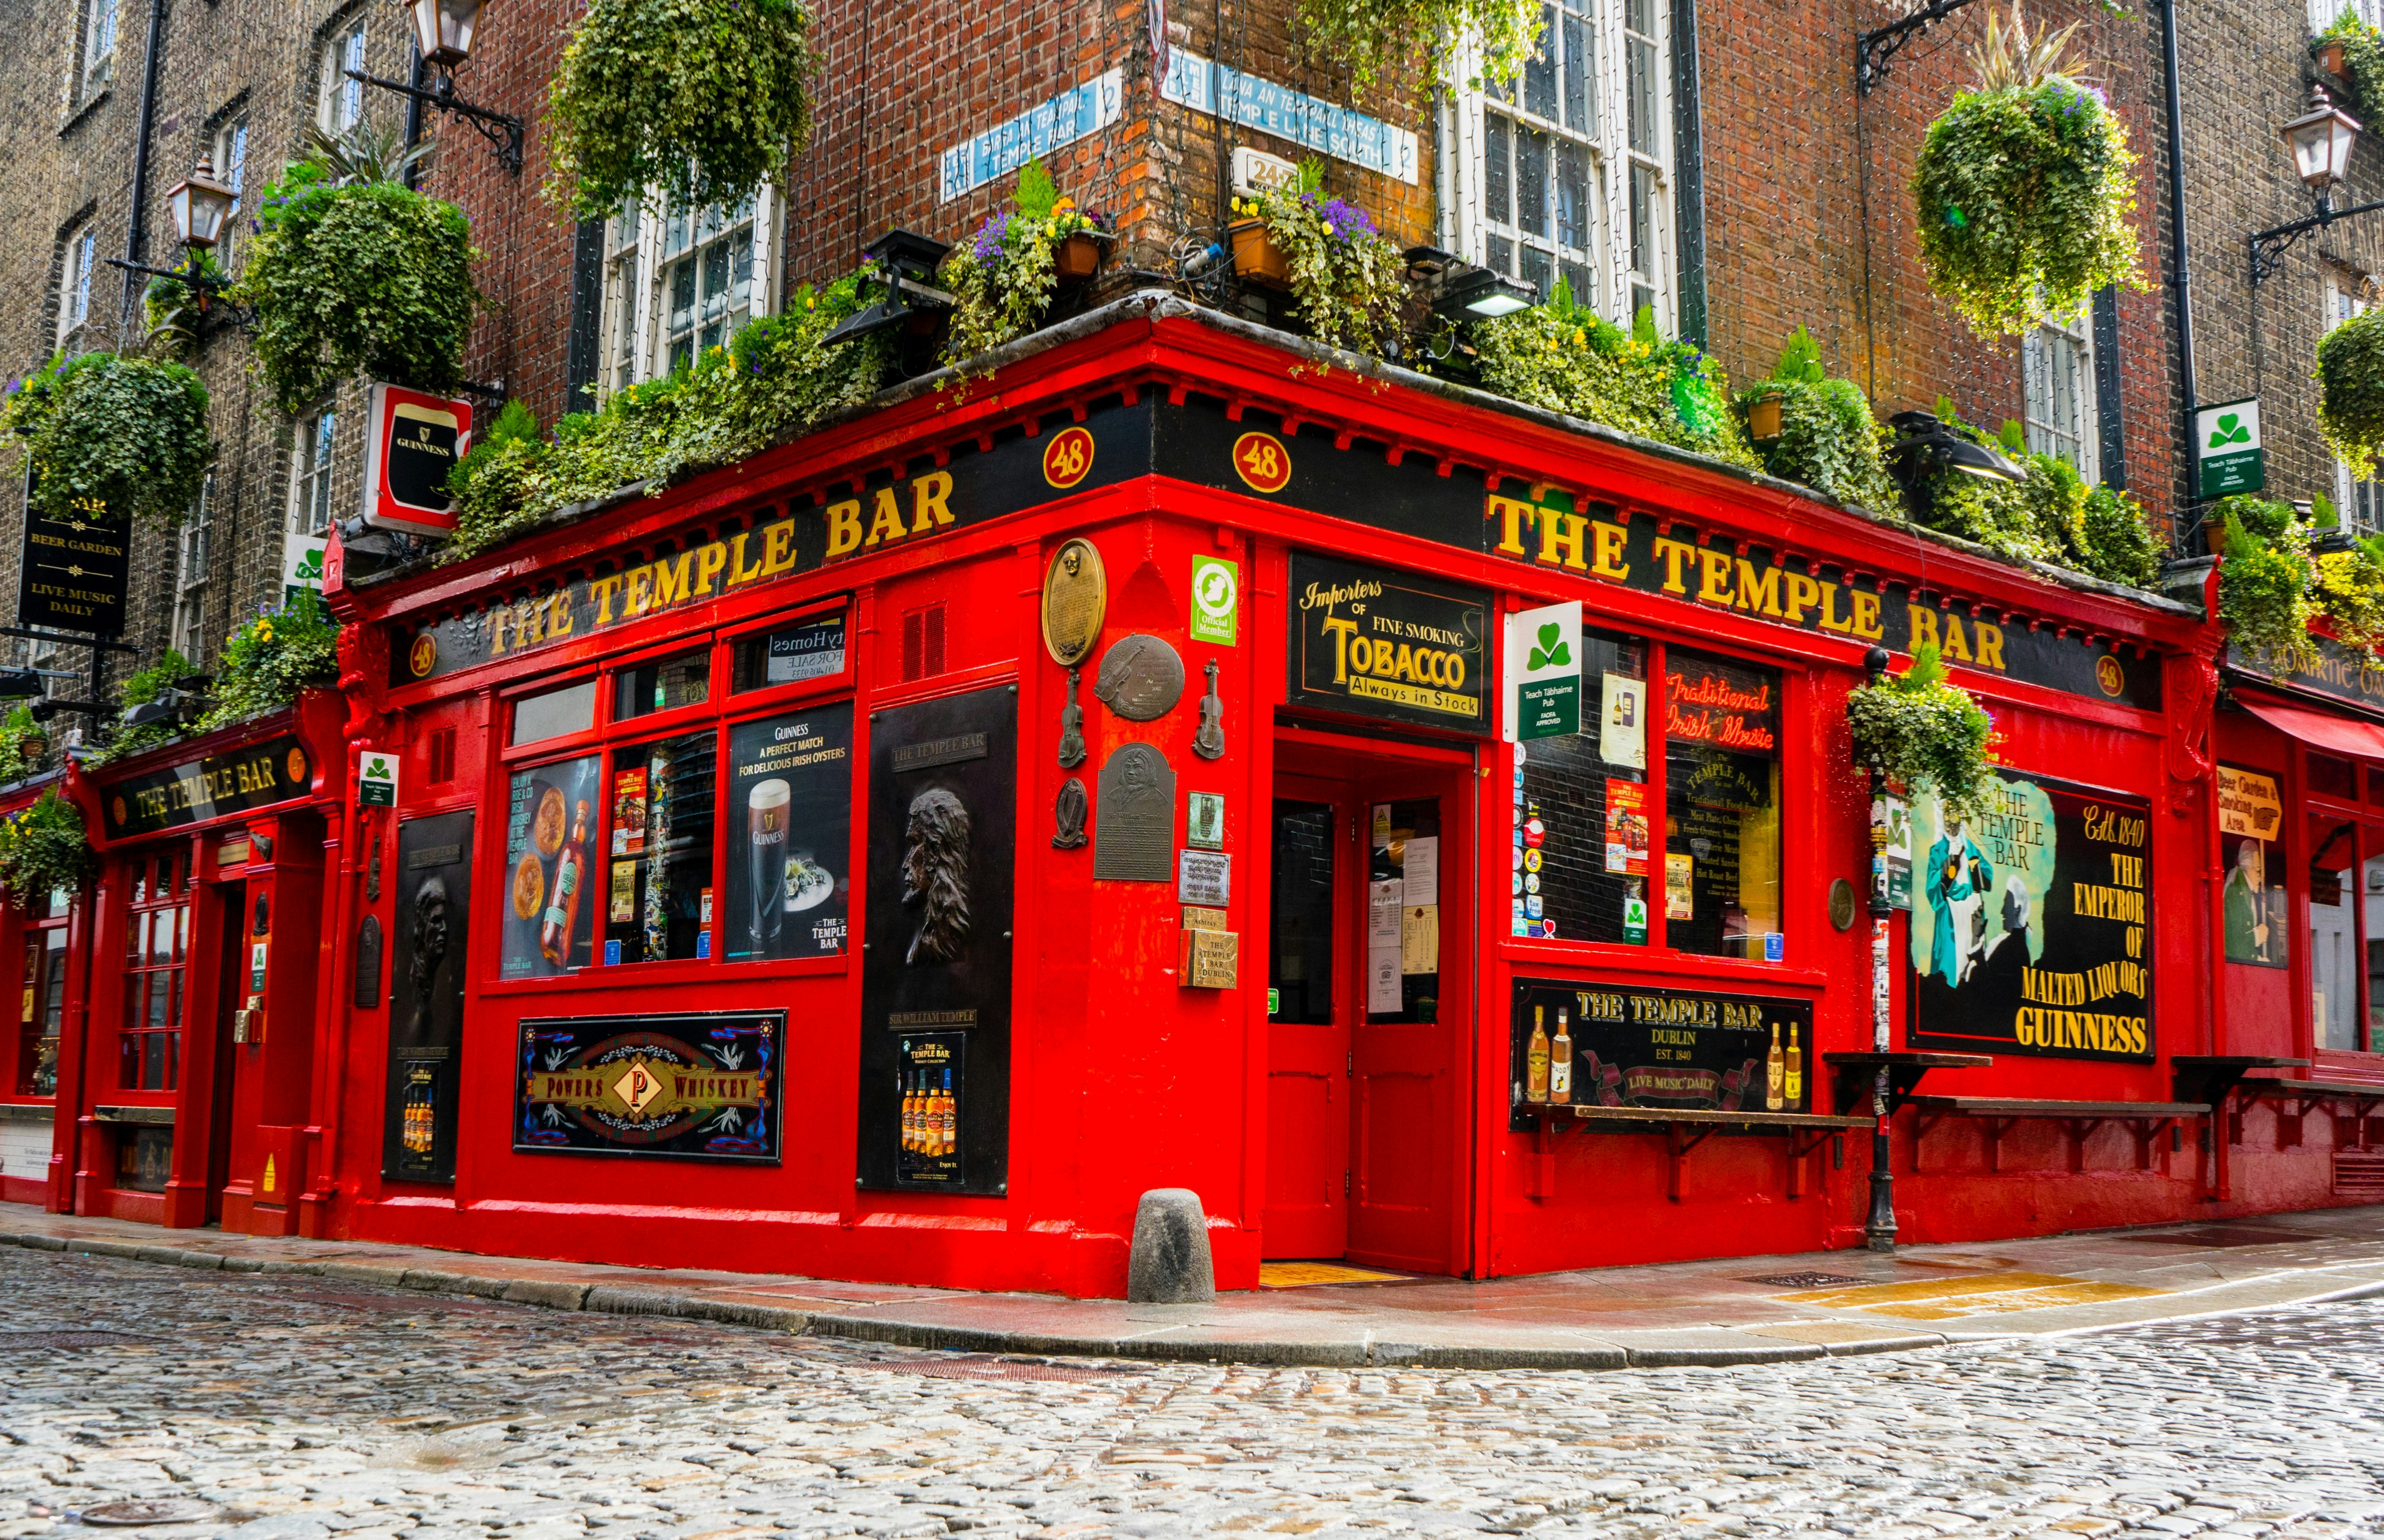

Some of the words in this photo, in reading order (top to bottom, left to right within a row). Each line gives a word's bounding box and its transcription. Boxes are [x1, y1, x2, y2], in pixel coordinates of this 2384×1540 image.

[1103, 86, 1115, 113] 2
[1222, 74, 1252, 98] LANA
[1257, 86, 1276, 106] AN
[1342, 116, 1377, 142] THEAS
[1330, 133, 1381, 166] SOUTH
[1399, 144, 1412, 170] 2
[397, 438, 449, 457] GUINNESS
[1051, 439, 1085, 478] 48
[1243, 440, 1279, 478] 48
[31, 533, 66, 548] BEER
[68, 540, 122, 557] GARDEN
[487, 591, 574, 655] THE
[590, 518, 798, 629] TEMPLE
[825, 471, 955, 562] BAR
[1486, 494, 1631, 584] THE
[1653, 537, 1884, 642] TEMPLE
[1908, 603, 2006, 671] BAR
[31, 583, 66, 597] LIVE
[69, 588, 116, 604] MUSIC
[1299, 579, 1382, 616] Importers
[50, 601, 95, 616] DAILY
[1351, 603, 1366, 616] OF
[1199, 623, 1230, 637] Member
[1202, 615, 1227, 627] Official
[1372, 616, 1403, 636] FINE
[1406, 622, 1464, 648] SMOKING
[416, 642, 430, 670] 48
[1322, 615, 1465, 690] TOBACCO
[2100, 661, 2119, 688] 48
[1352, 677, 1406, 700] Always
[1414, 689, 1428, 704] in
[1434, 692, 1476, 713] Stock
[1525, 689, 1543, 700] Teach
[1666, 673, 1770, 711] Traditional
[1542, 698, 1555, 708] Pub
[775, 723, 809, 740] GUINNESS
[1536, 717, 1561, 727] APPROVED
[1665, 704, 1712, 739] Irish
[1718, 715, 1775, 749] Music
[760, 748, 766, 758] A
[766, 741, 798, 758] PERFECT
[798, 736, 824, 751] MATCH
[893, 748, 914, 762] THE
[916, 738, 959, 758] TEMPLE
[961, 734, 985, 750] BAR
[739, 765, 754, 777] FOR
[754, 758, 791, 775] DELICIOUS
[792, 754, 812, 767] IRISH
[813, 747, 846, 763] OYSTERS
[136, 785, 168, 818] THE
[168, 767, 235, 810] TEMPLE
[236, 757, 277, 794] BAR
[618, 777, 634, 786] TEMPLE
[1687, 763, 1734, 790] TEMPLE
[1737, 771, 1760, 802] BAR
[2217, 770, 2237, 792] Beer
[2239, 776, 2269, 799] Garden
[512, 789, 522, 801] ROE
[526, 786, 533, 799] CO
[1610, 788, 1631, 797] TEMPLE
[1632, 791, 1644, 799] BAR
[1686, 792, 1724, 808] Traditional
[511, 801, 524, 814] IRISH
[1994, 789, 2028, 818] THE
[2218, 791, 2252, 818] Smoking
[511, 812, 532, 826] WHISKEY
[2225, 813, 2245, 832] Area
[753, 829, 784, 846] GUINNESS
[1981, 813, 2045, 847] TEMPLE
[2118, 816, 2145, 848] 1840
[509, 838, 527, 852] TEMPLE
[509, 852, 519, 865] BAR
[1996, 840, 2030, 871] BAR
[1697, 868, 1707, 878] Hot
[2111, 853, 2144, 889] THE
[1529, 906, 1541, 915] free
[1530, 899, 1539, 907] tax
[2073, 882, 2146, 924] EMPEROR
[823, 918, 837, 927] THE
[1194, 919, 1217, 927] Ashtray
[812, 925, 847, 940] TEMPLE
[820, 938, 839, 949] BAR
[1210, 942, 1224, 950] THE
[2125, 926, 2145, 959] OF
[1203, 949, 1231, 959] TEMPLE
[503, 962, 521, 971] TEMPLE
[521, 961, 532, 969] BAR
[1202, 968, 1231, 978] DUBLIN
[1210, 960, 1224, 969] BAR
[2021, 966, 2086, 1006] MALTED
[2086, 960, 2148, 1002] LIQUORS
[889, 1014, 902, 1024] SIR
[903, 1012, 940, 1023] WILLIAM
[940, 1011, 975, 1022] TEMPLE
[1576, 992, 1625, 1022] THE
[1630, 995, 1717, 1028] TEMPLE
[1722, 1002, 1764, 1032] BAR
[1651, 1029, 1696, 1046] DUBLIN
[2015, 1006, 2147, 1054] GUINNESS
[911, 1050, 935, 1060] TEMPLE
[936, 1049, 951, 1058] BAR
[1656, 1049, 1674, 1061] EST.
[1675, 1049, 1692, 1062] 1840
[1551, 1062, 1571, 1074] PADDY
[546, 1077, 604, 1099] POWERS
[630, 1069, 649, 1108] P
[674, 1076, 750, 1099] WHISKEY
[1629, 1075, 1652, 1090] LIVE
[1654, 1076, 1685, 1091] MUSIC
[1686, 1078, 1716, 1092] DAILY
